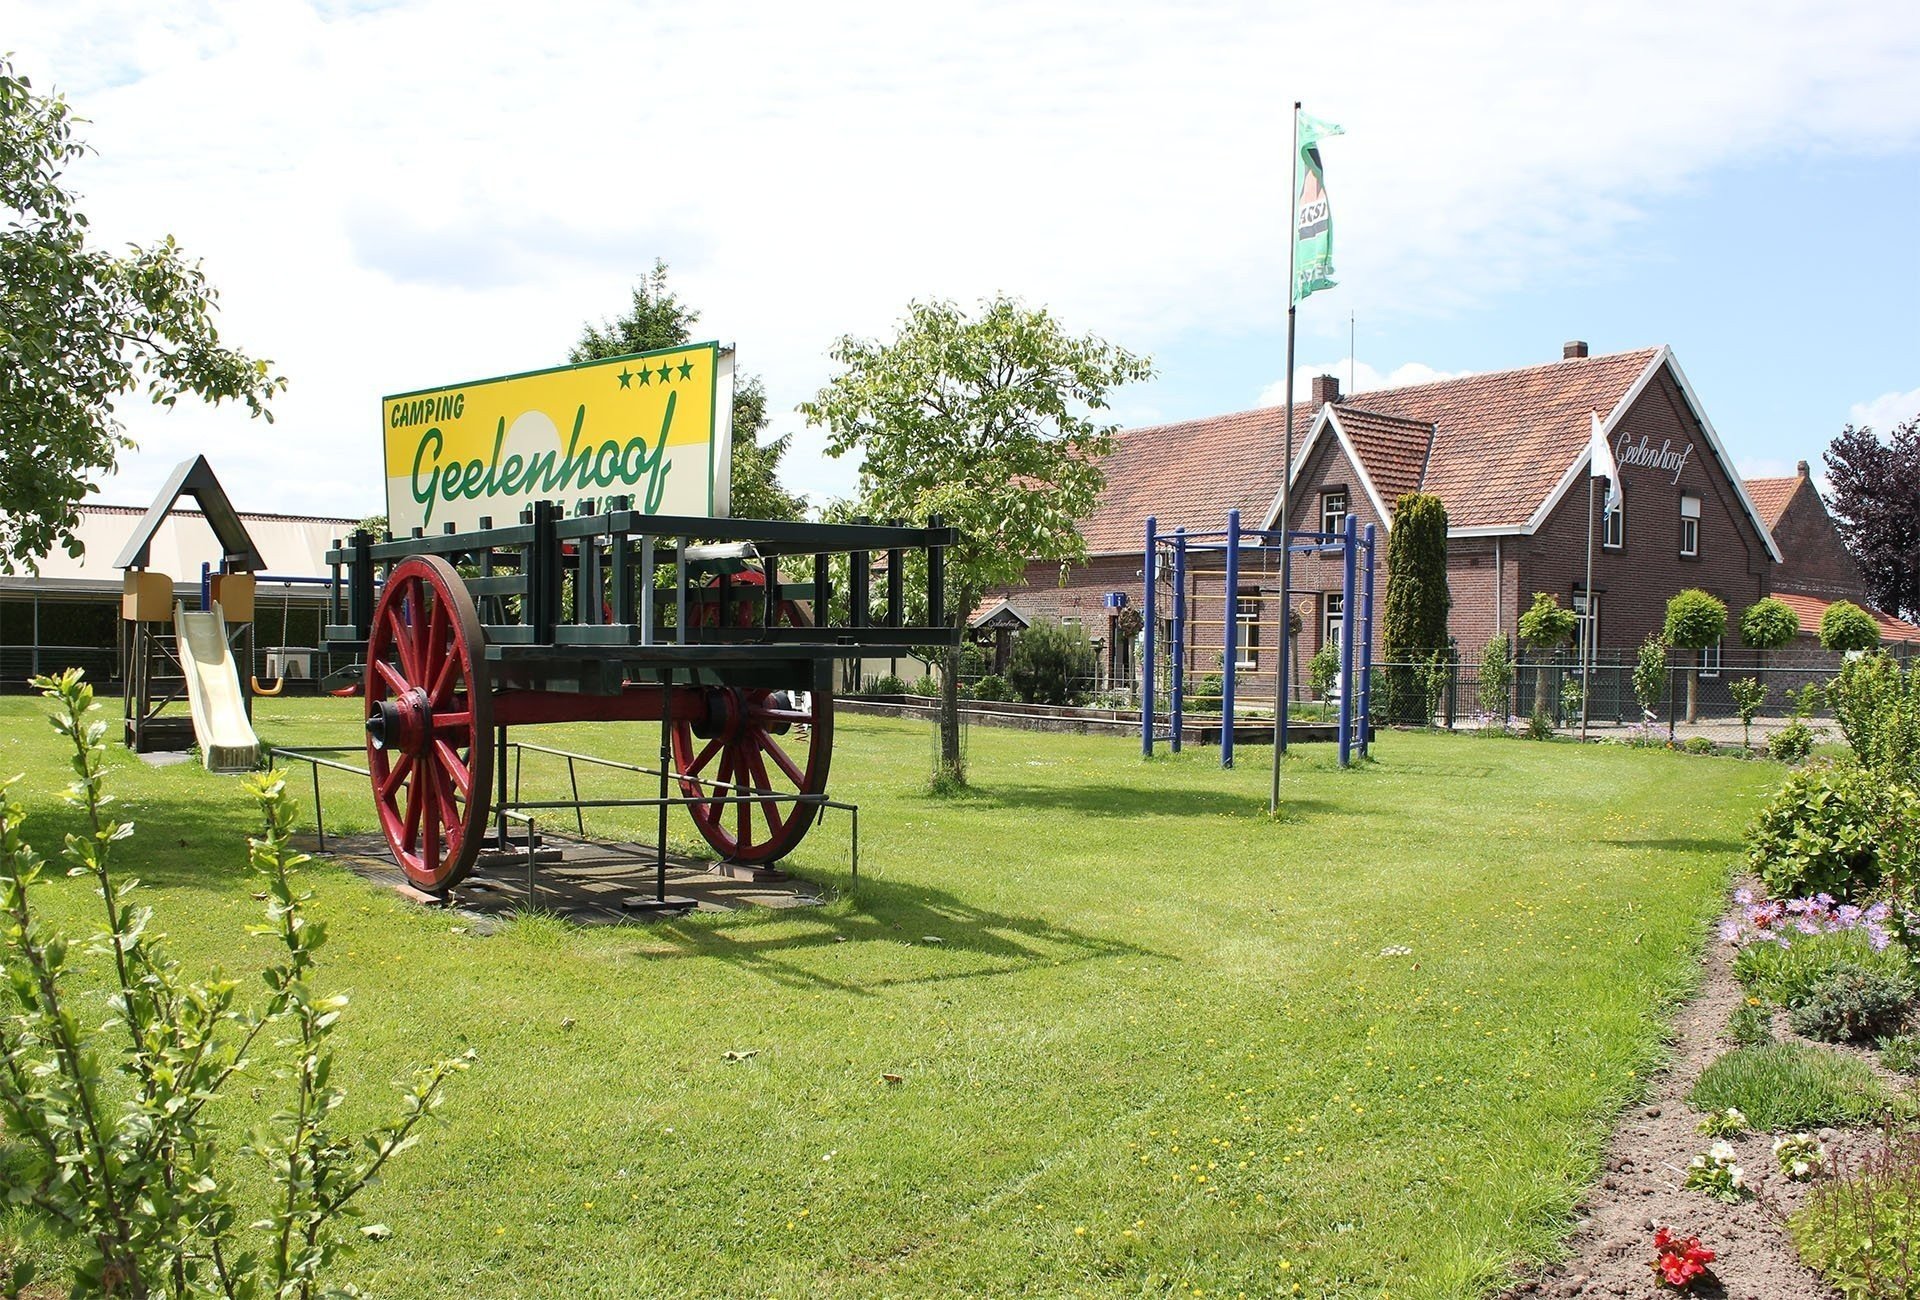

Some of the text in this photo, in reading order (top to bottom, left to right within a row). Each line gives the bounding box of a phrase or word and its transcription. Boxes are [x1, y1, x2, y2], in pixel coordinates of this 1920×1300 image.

[391, 393, 464, 428] CAMPING
[411, 390, 677, 528] Geelenhoof
[1615, 431, 1694, 486] Geelenhoof
